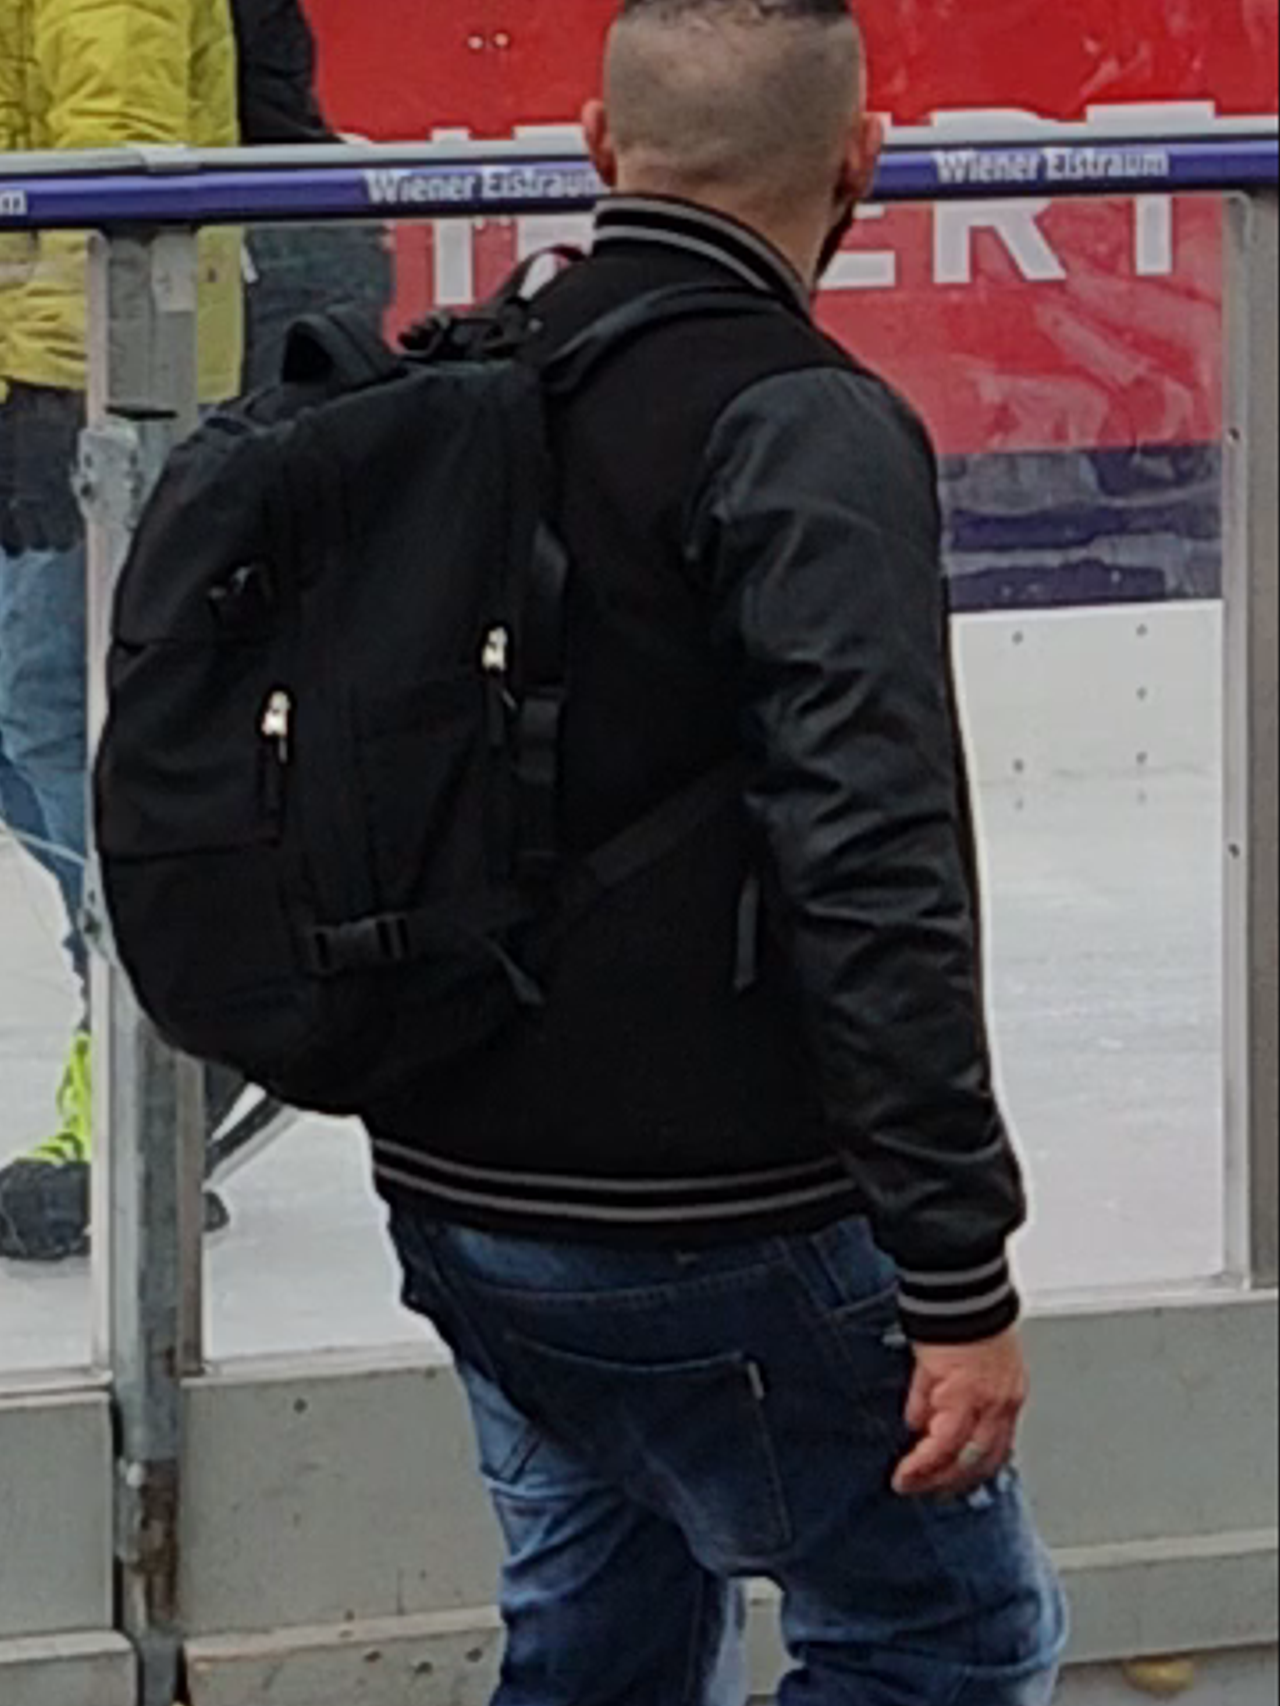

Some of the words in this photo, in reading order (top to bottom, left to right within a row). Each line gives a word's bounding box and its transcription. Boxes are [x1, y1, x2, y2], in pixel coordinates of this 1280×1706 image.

[932, 148, 1039, 184] Wiener
[1041, 145, 1169, 181] Eistraum
[364, 168, 476, 204] Wiener
